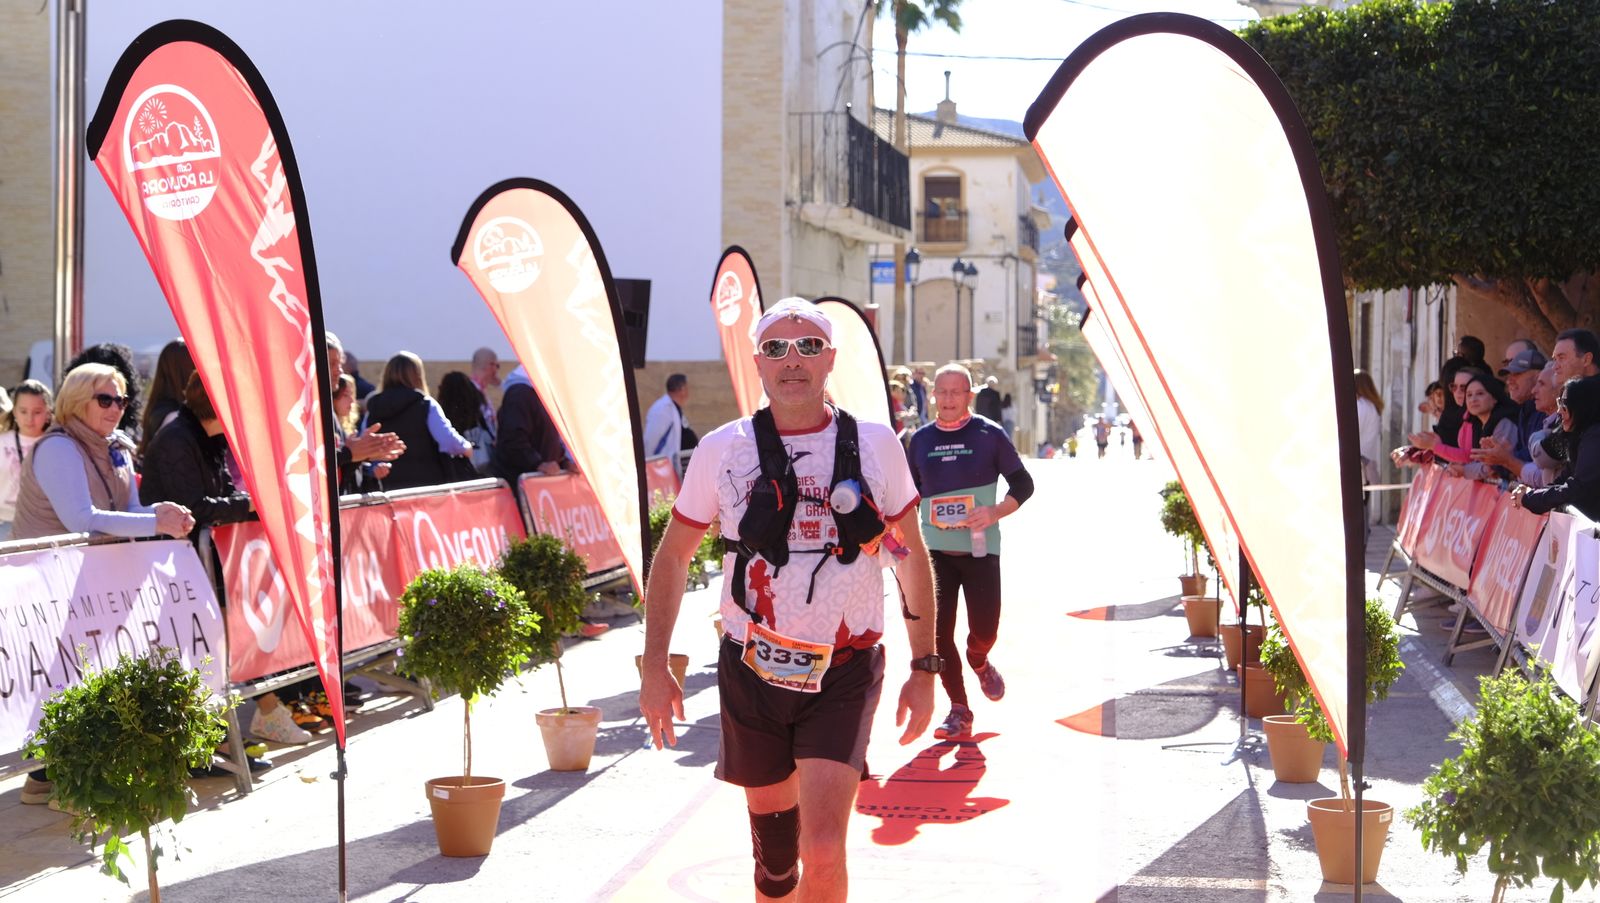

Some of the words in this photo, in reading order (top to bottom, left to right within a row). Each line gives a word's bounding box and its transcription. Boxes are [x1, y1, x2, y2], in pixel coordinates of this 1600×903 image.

[936, 503, 966, 517] 262
[169, 580, 197, 604] DE
[756, 640, 813, 667] 333
